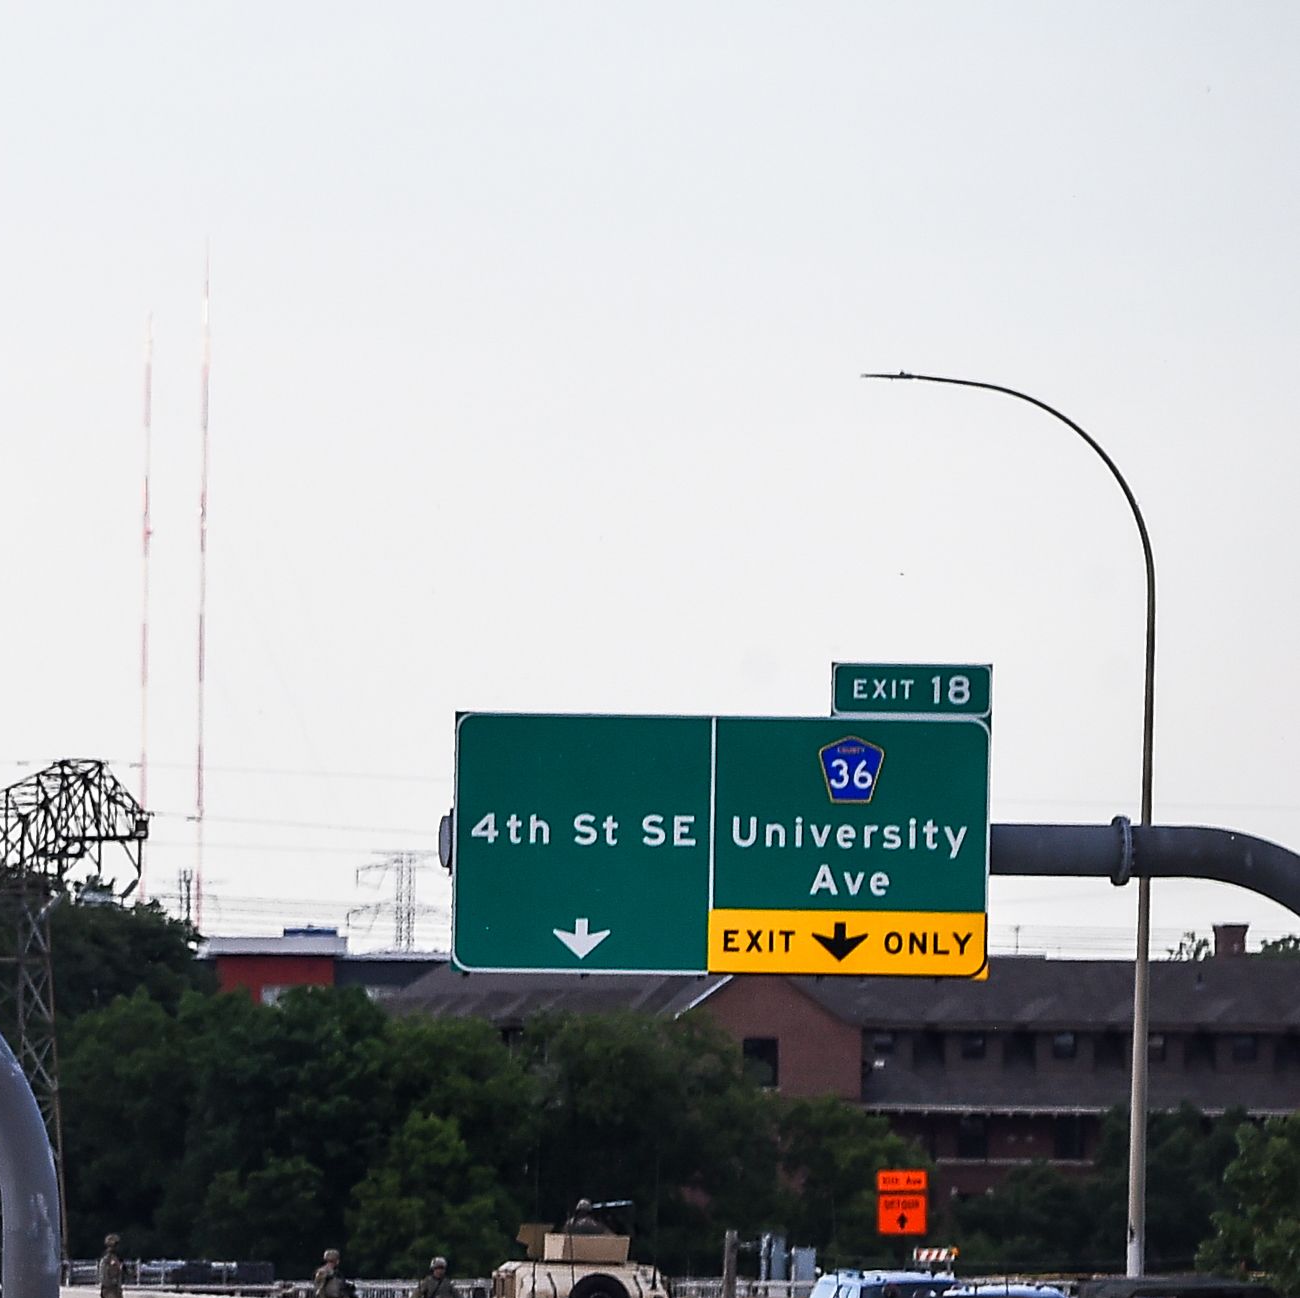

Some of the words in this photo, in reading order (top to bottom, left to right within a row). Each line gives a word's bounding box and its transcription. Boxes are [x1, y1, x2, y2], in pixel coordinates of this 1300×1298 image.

[854, 678, 914, 700] EXIT
[931, 676, 971, 705] 18
[830, 758, 873, 790] 36
[471, 813, 550, 845] 4th
[573, 814, 619, 847] St
[642, 814, 697, 847] SE
[732, 816, 968, 859] University
[810, 864, 890, 897] Ave
[722, 929, 796, 953] EXIT
[884, 931, 973, 956] ONLY
